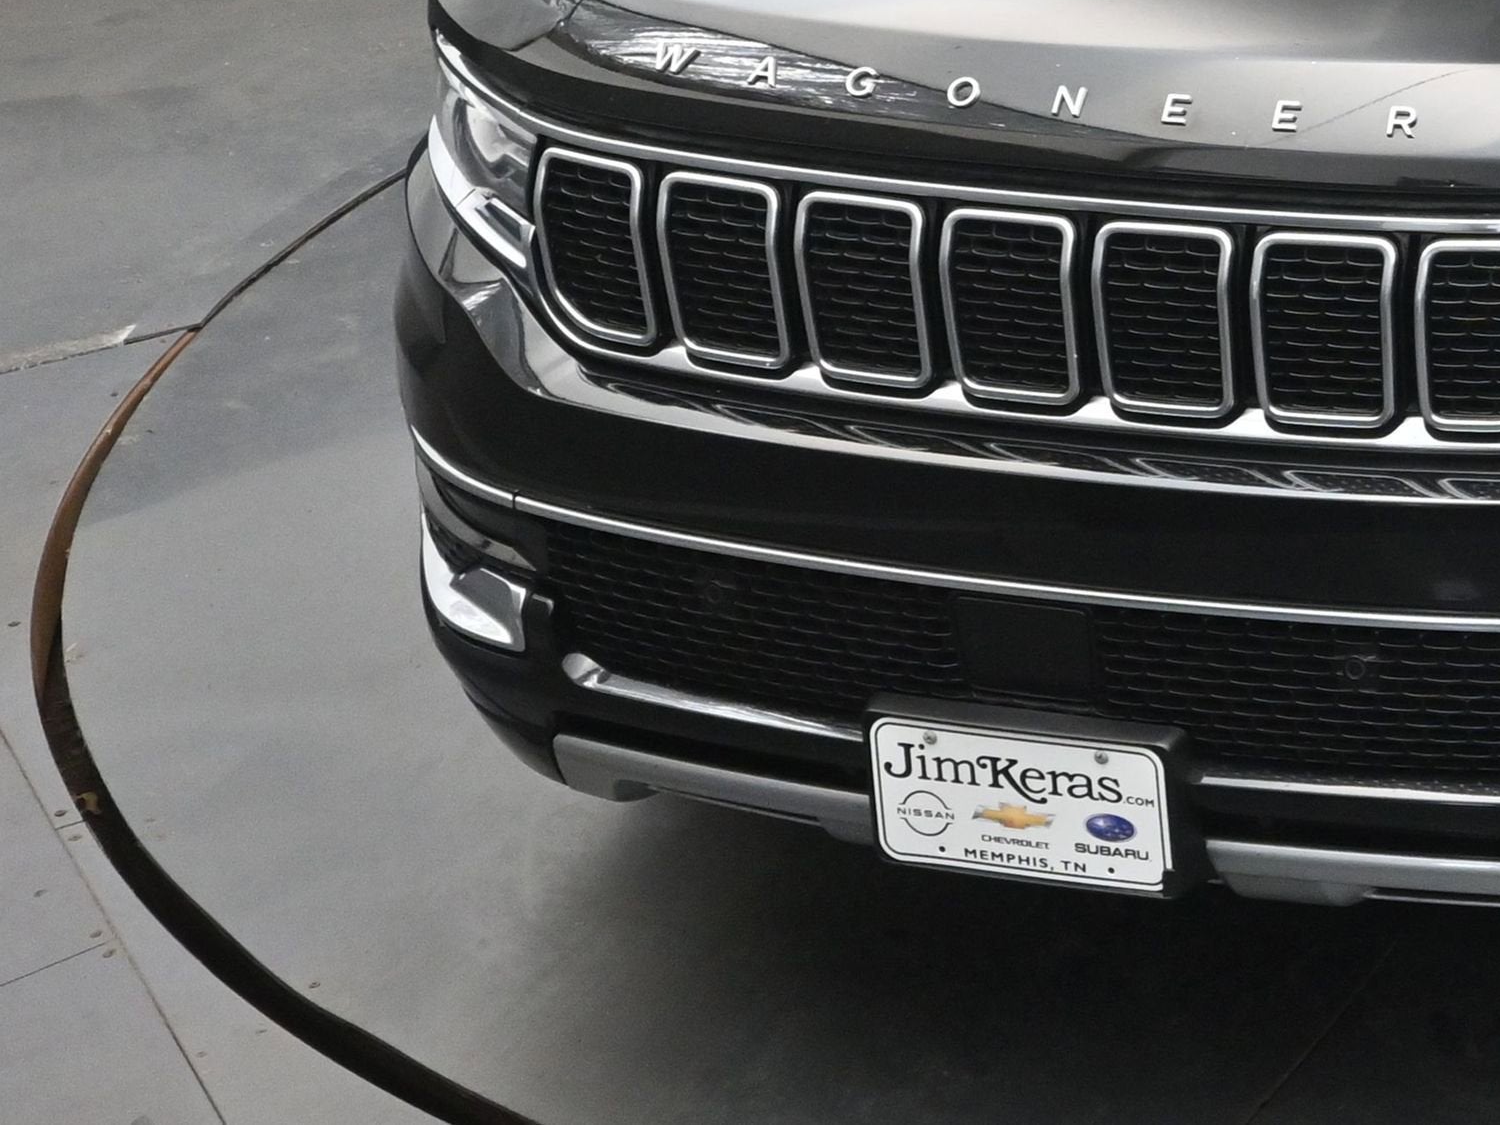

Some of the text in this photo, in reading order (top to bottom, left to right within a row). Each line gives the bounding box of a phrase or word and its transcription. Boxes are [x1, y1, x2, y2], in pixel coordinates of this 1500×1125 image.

[653, 42, 1419, 139] WAGONEER
[896, 806, 955, 821] NISSAN
[980, 834, 1050, 850] CHEVROLET
[1074, 842, 1149, 861] SUBARU
[964, 848, 1087, 873] MEMPHIS, TN
